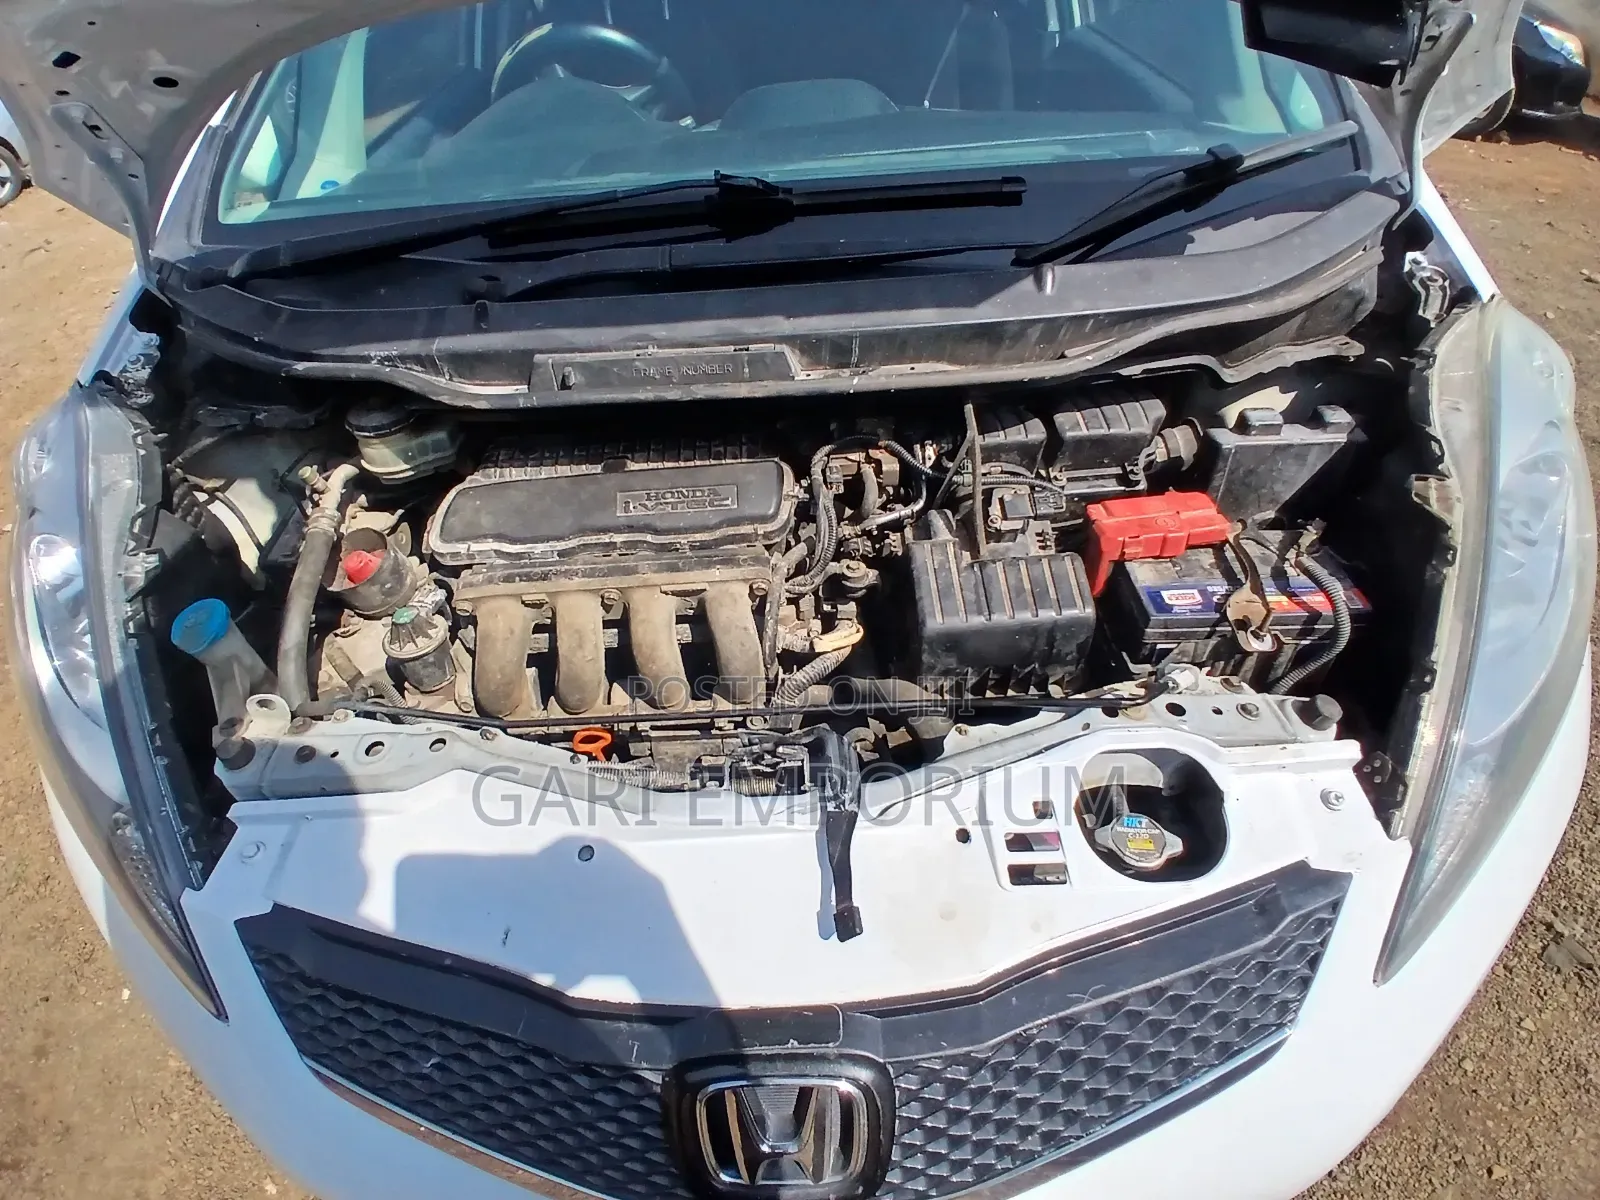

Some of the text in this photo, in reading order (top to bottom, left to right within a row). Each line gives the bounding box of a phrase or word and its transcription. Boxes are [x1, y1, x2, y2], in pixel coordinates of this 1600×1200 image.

[682, 363, 734, 377] NUMBER
[645, 488, 721, 501] HONDA
[1123, 816, 1149, 828] HKT
